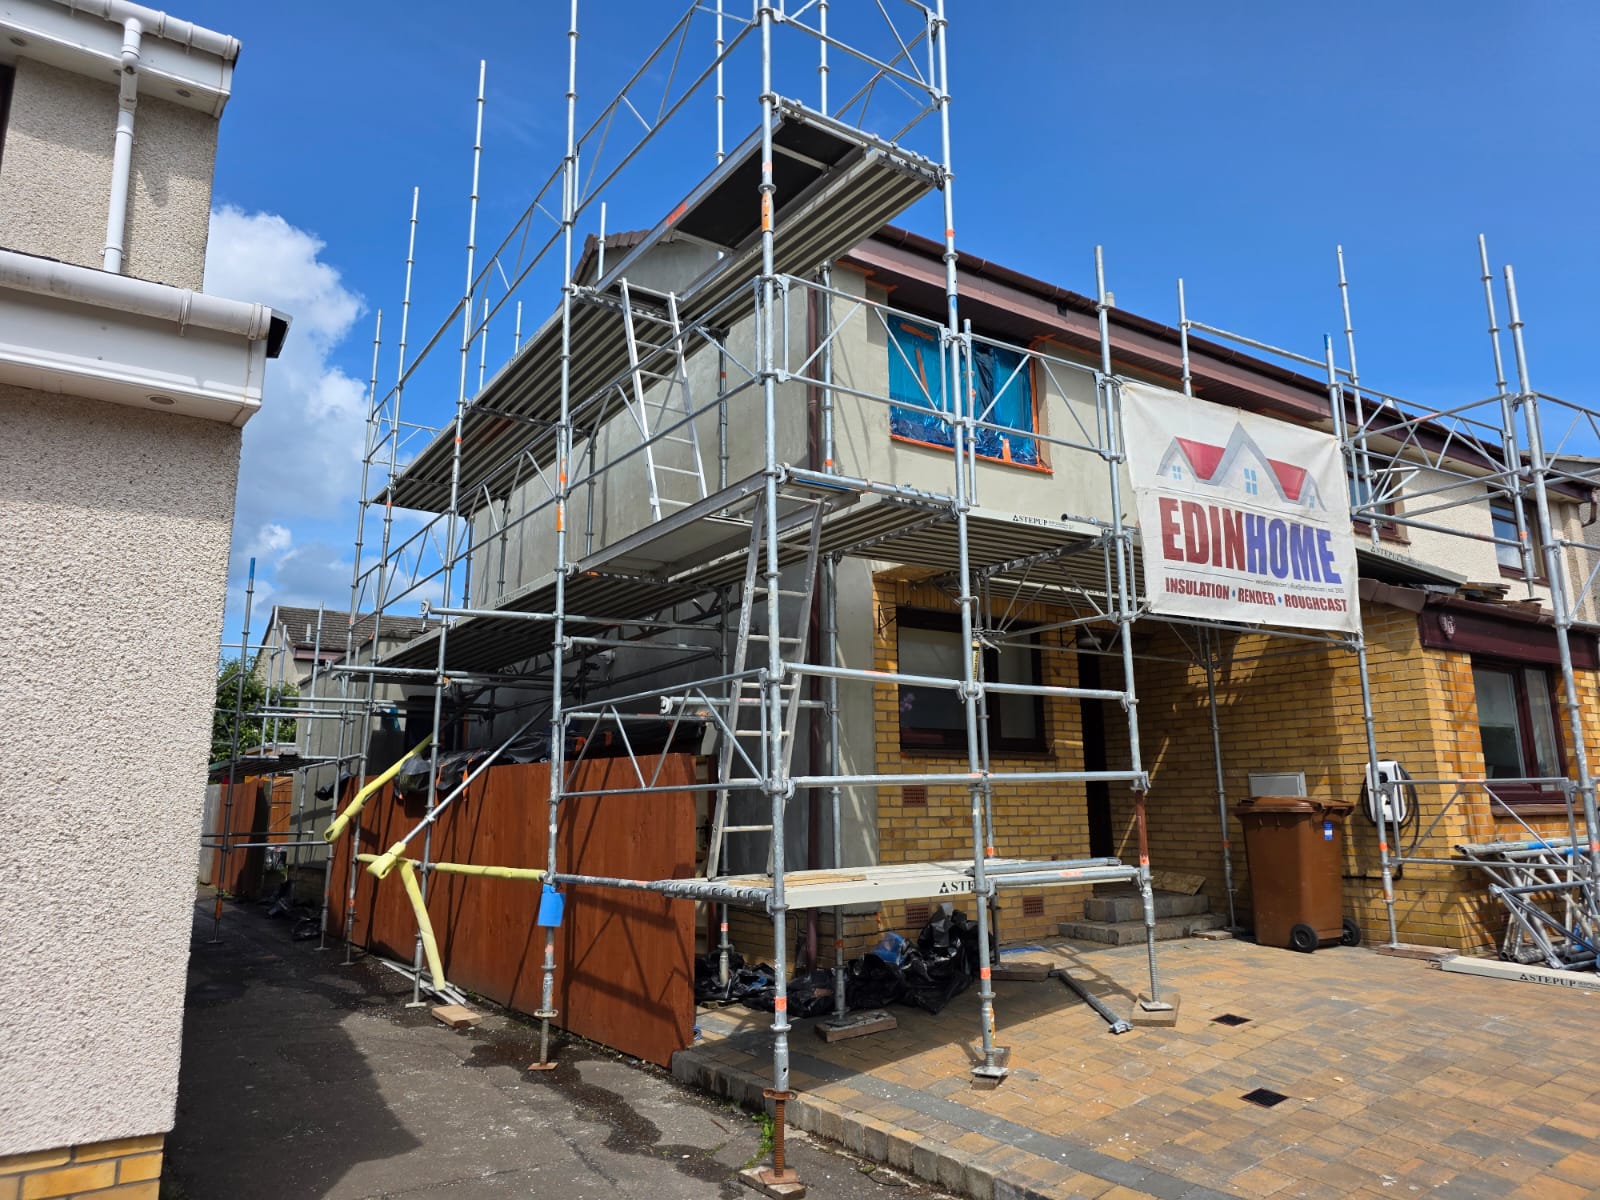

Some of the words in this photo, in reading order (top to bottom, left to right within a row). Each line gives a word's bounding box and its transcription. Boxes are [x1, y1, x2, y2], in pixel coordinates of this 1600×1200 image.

[1158, 496, 1342, 585] EDINHOME
[1165, 577, 1230, 600] INSULATION
[1237, 587, 1276, 606] RENDER
[1284, 593, 1347, 612] ROUGHCAST
[1529, 973, 1577, 987] STEPUP
